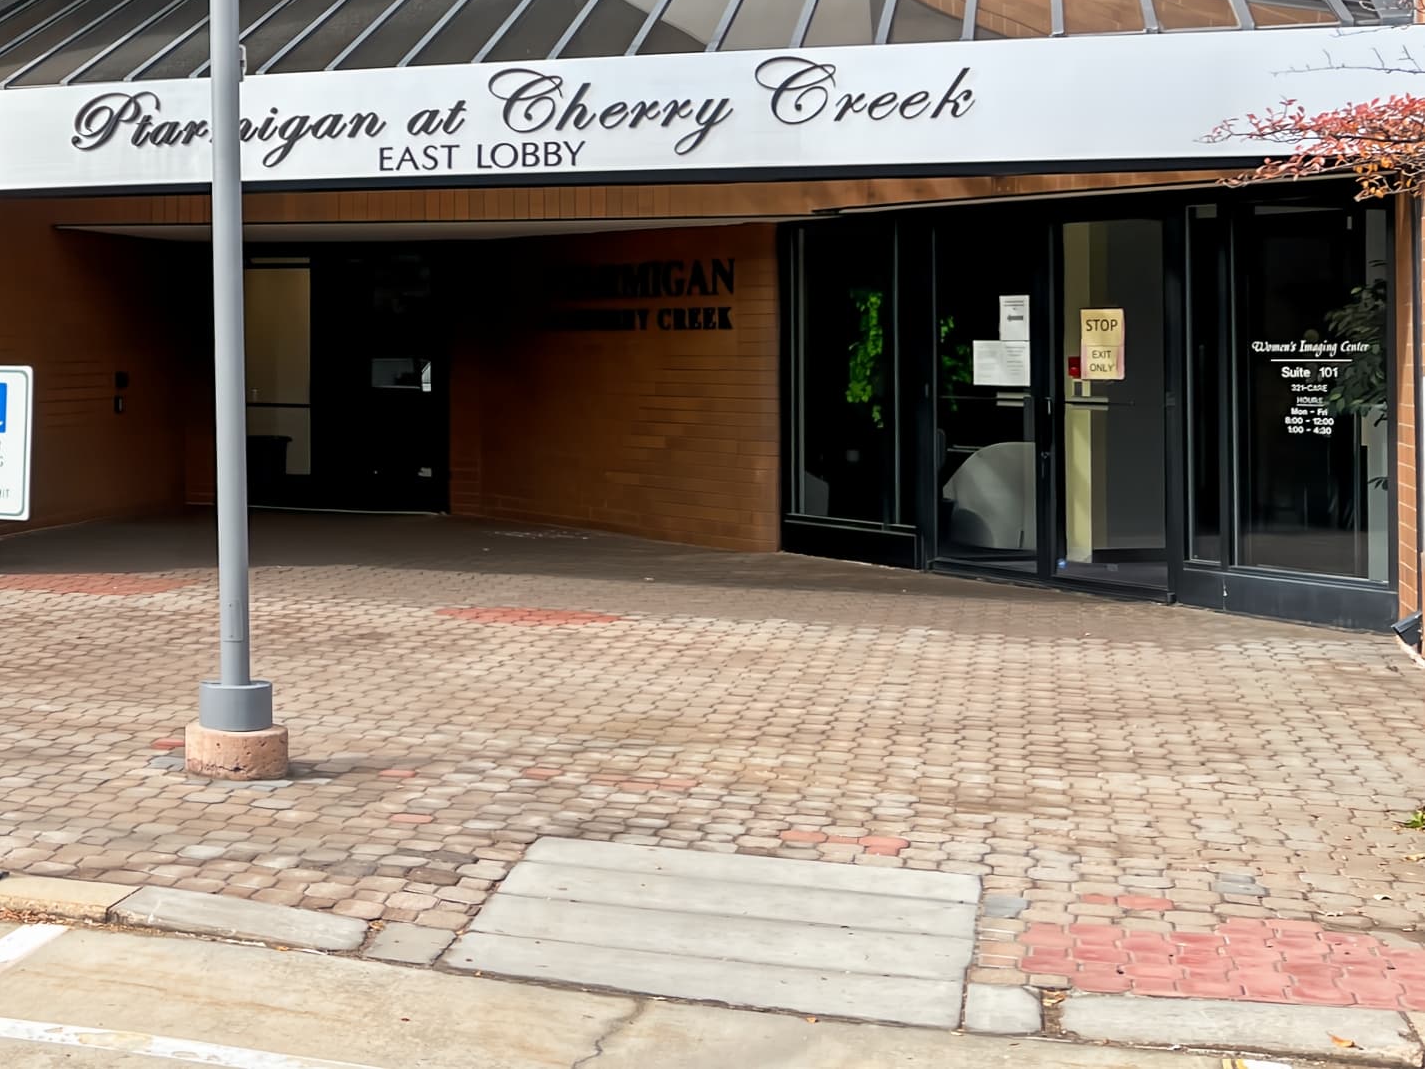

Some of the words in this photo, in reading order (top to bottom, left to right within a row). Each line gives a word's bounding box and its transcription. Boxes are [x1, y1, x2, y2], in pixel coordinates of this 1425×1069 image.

[407, 99, 467, 136] at
[488, 68, 733, 156] Cherry
[754, 56, 977, 125] Creek
[378, 144, 461, 173] EAST
[476, 140, 586, 170] LOBBY
[1085, 319, 1118, 332] STOP
[1251, 341, 1297, 352] Women's
[1299, 339, 1337, 357] Imaging
[1340, 340, 1370, 352] Center
[1092, 350, 1112, 359] EXIT
[1089, 363, 1115, 372] ONLY
[1281, 366, 1311, 378] Suite
[1319, 366, 1339, 378] 101
[1290, 407, 1308, 415] Mon
[1317, 408, 1328, 416] Fri
[1313, 417, 1335, 425] 12:00
